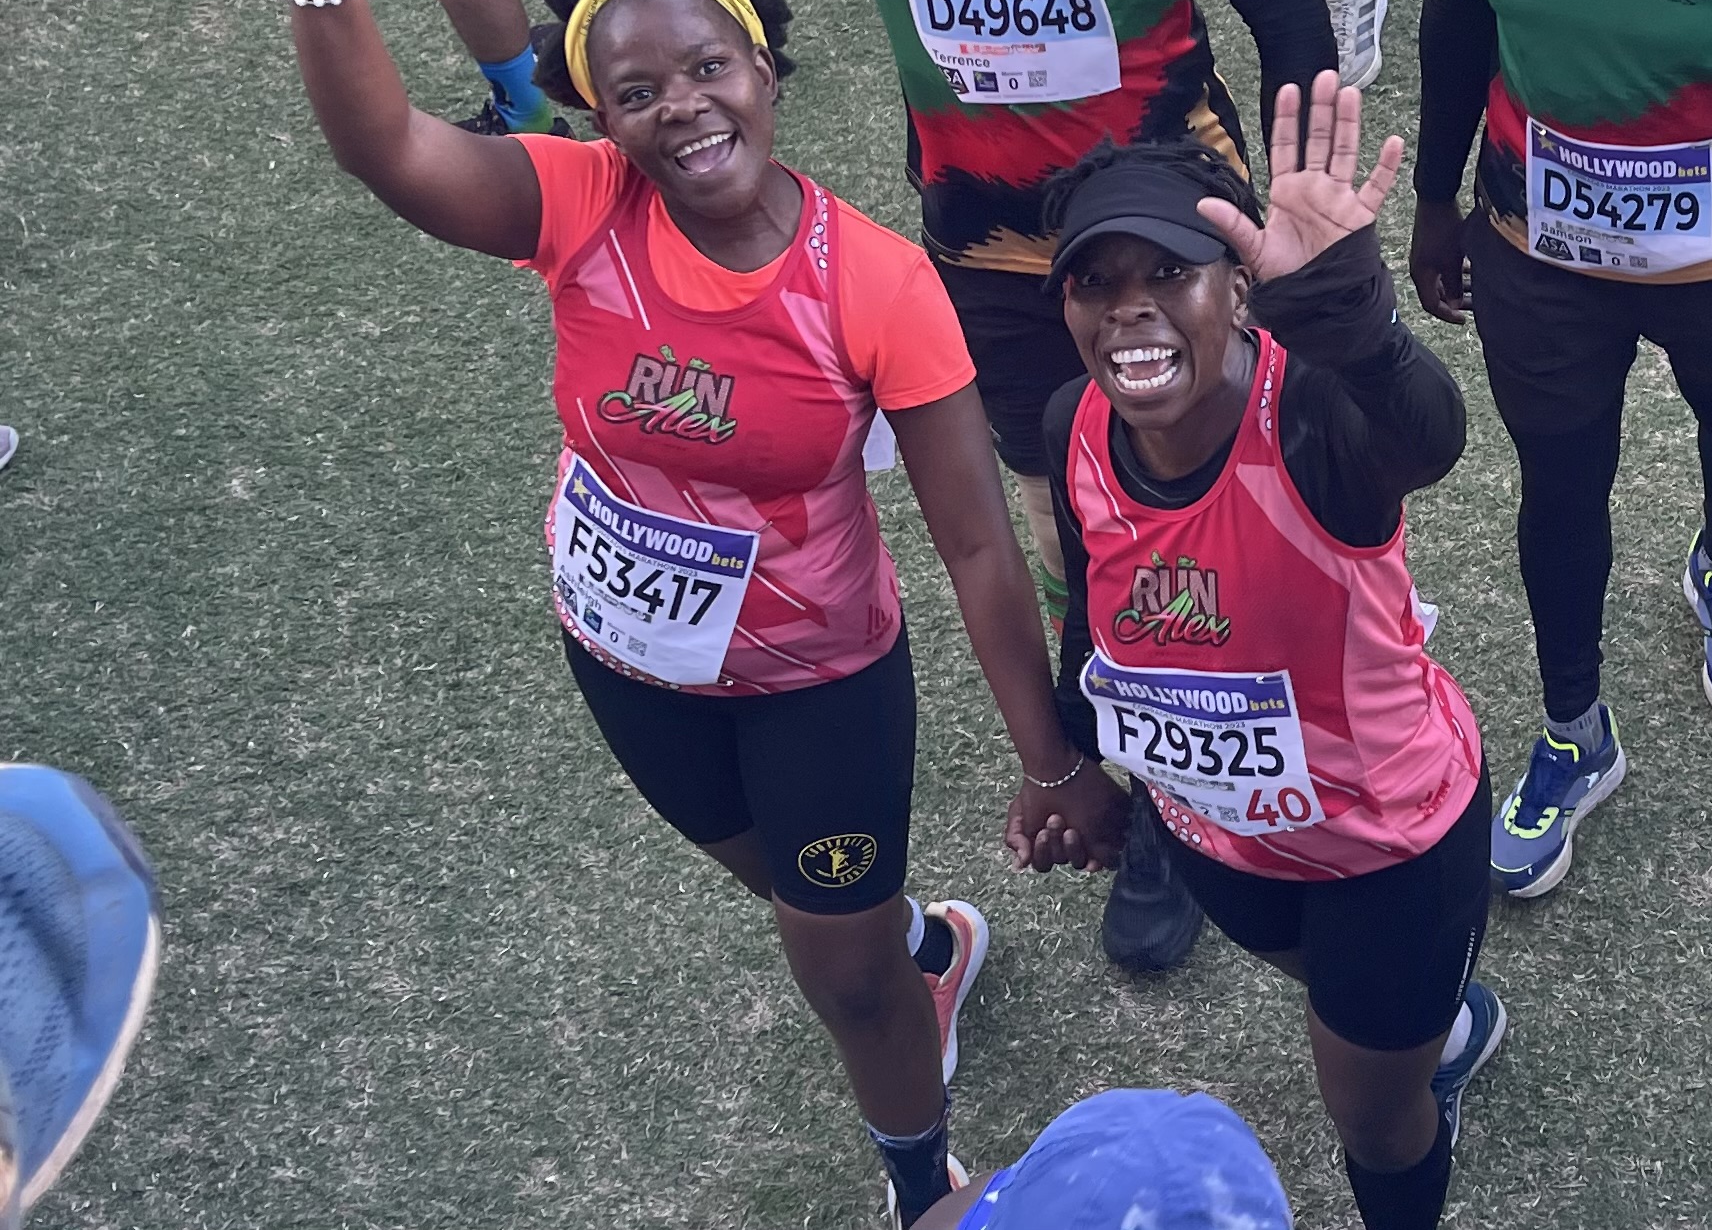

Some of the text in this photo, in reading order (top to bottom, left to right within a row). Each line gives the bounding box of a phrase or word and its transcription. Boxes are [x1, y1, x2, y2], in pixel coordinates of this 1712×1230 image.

[931, 47, 992, 69] Terrence
[1008, 77, 1020, 91] 0
[1543, 167, 1700, 232] D54279
[1539, 235, 1570, 254] ASA
[1540, 220, 1593, 245] Samson
[1611, 255, 1621, 266] 0
[626, 354, 735, 419] RUN
[598, 388, 738, 444] Alex
[568, 515, 723, 627] F53417
[627, 552, 678, 573] MARATHON
[677, 567, 699, 578] 2023
[1131, 566, 1218, 618] RUN
[609, 631, 619, 644] 0
[1112, 588, 1232, 647] Alex
[1112, 704, 1286, 778] F29325
[1245, 786, 1312, 827] 40
